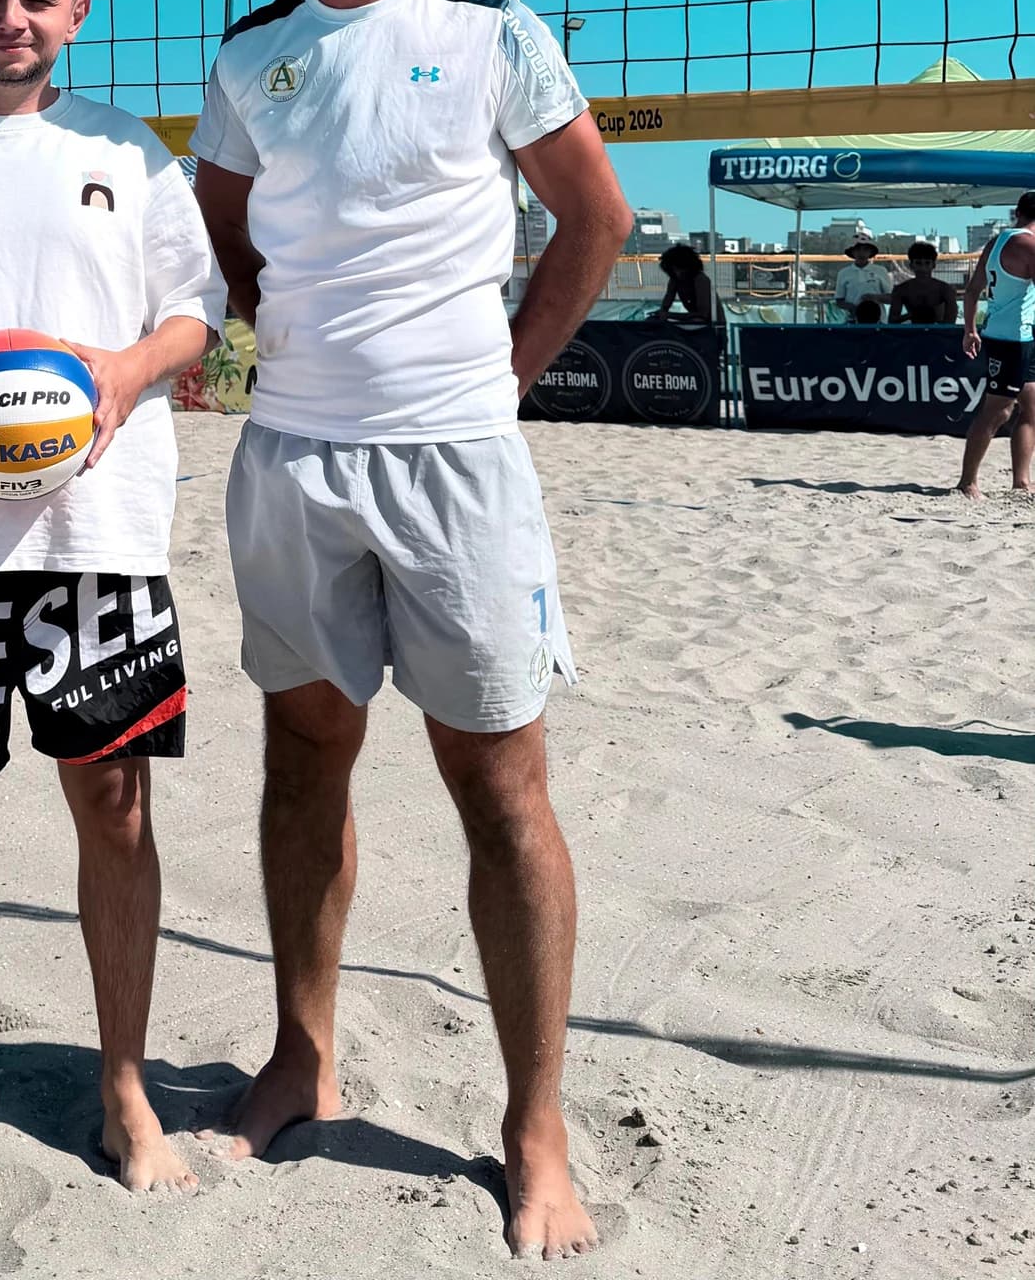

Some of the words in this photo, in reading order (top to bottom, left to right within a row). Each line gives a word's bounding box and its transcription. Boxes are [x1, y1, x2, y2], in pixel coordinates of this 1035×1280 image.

[503, 7, 556, 93] RMOUR
[596, 111, 625, 136] Cup
[628, 107, 663, 130] 2026
[721, 155, 828, 180] TUBORG
[566, 370, 599, 388] ROMA
[633, 372, 663, 389] CAFE
[664, 374, 698, 391] ROMA
[748, 365, 987, 412] EuroVolley
[31, 391, 71, 405] PRO
[100, 639, 179, 691] LIVING
